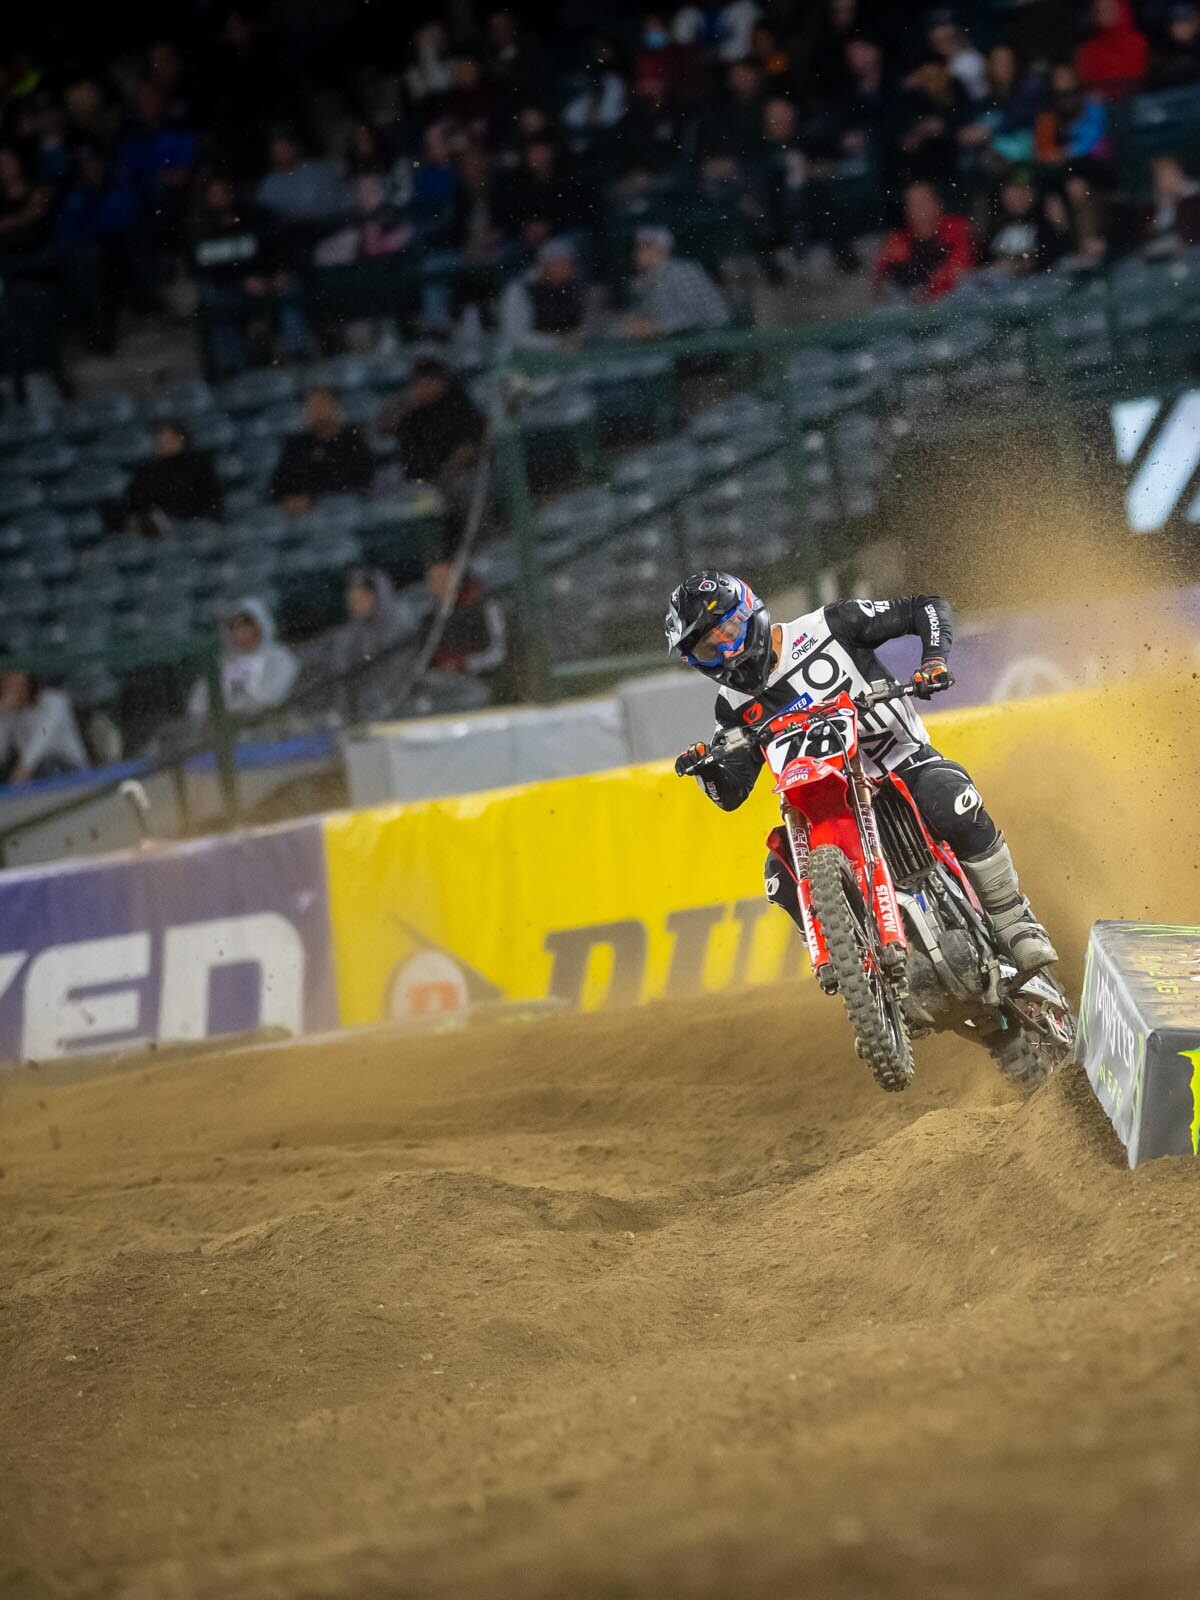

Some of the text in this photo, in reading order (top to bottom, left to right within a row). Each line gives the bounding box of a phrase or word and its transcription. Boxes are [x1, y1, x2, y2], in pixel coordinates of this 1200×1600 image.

[924, 603, 941, 647] FIREPOWER
[775, 719, 848, 775] 78
[876, 884, 898, 934] MAXXIS
